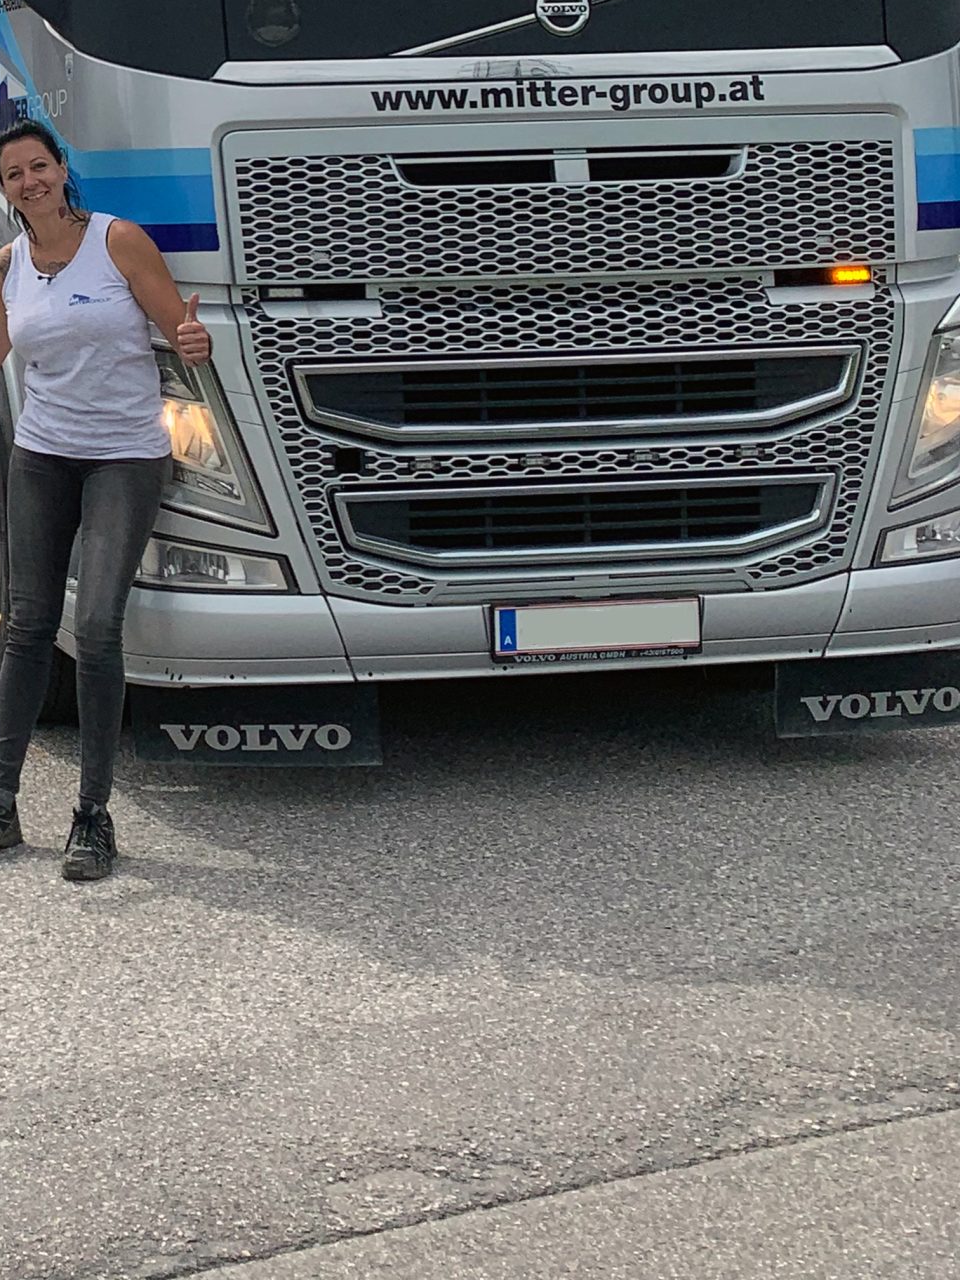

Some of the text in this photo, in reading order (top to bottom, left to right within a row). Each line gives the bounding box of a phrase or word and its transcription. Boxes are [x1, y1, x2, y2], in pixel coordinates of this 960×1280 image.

[539, 4, 588, 14] VOLVO
[370, 75, 765, 112] www.mitter-group.at
[504, 635, 513, 646] A
[513, 654, 556, 663] VOLVO
[559, 651, 598, 661] AUSTRIA
[800, 686, 960, 722] VOLVO
[159, 722, 353, 752] VOLVO
